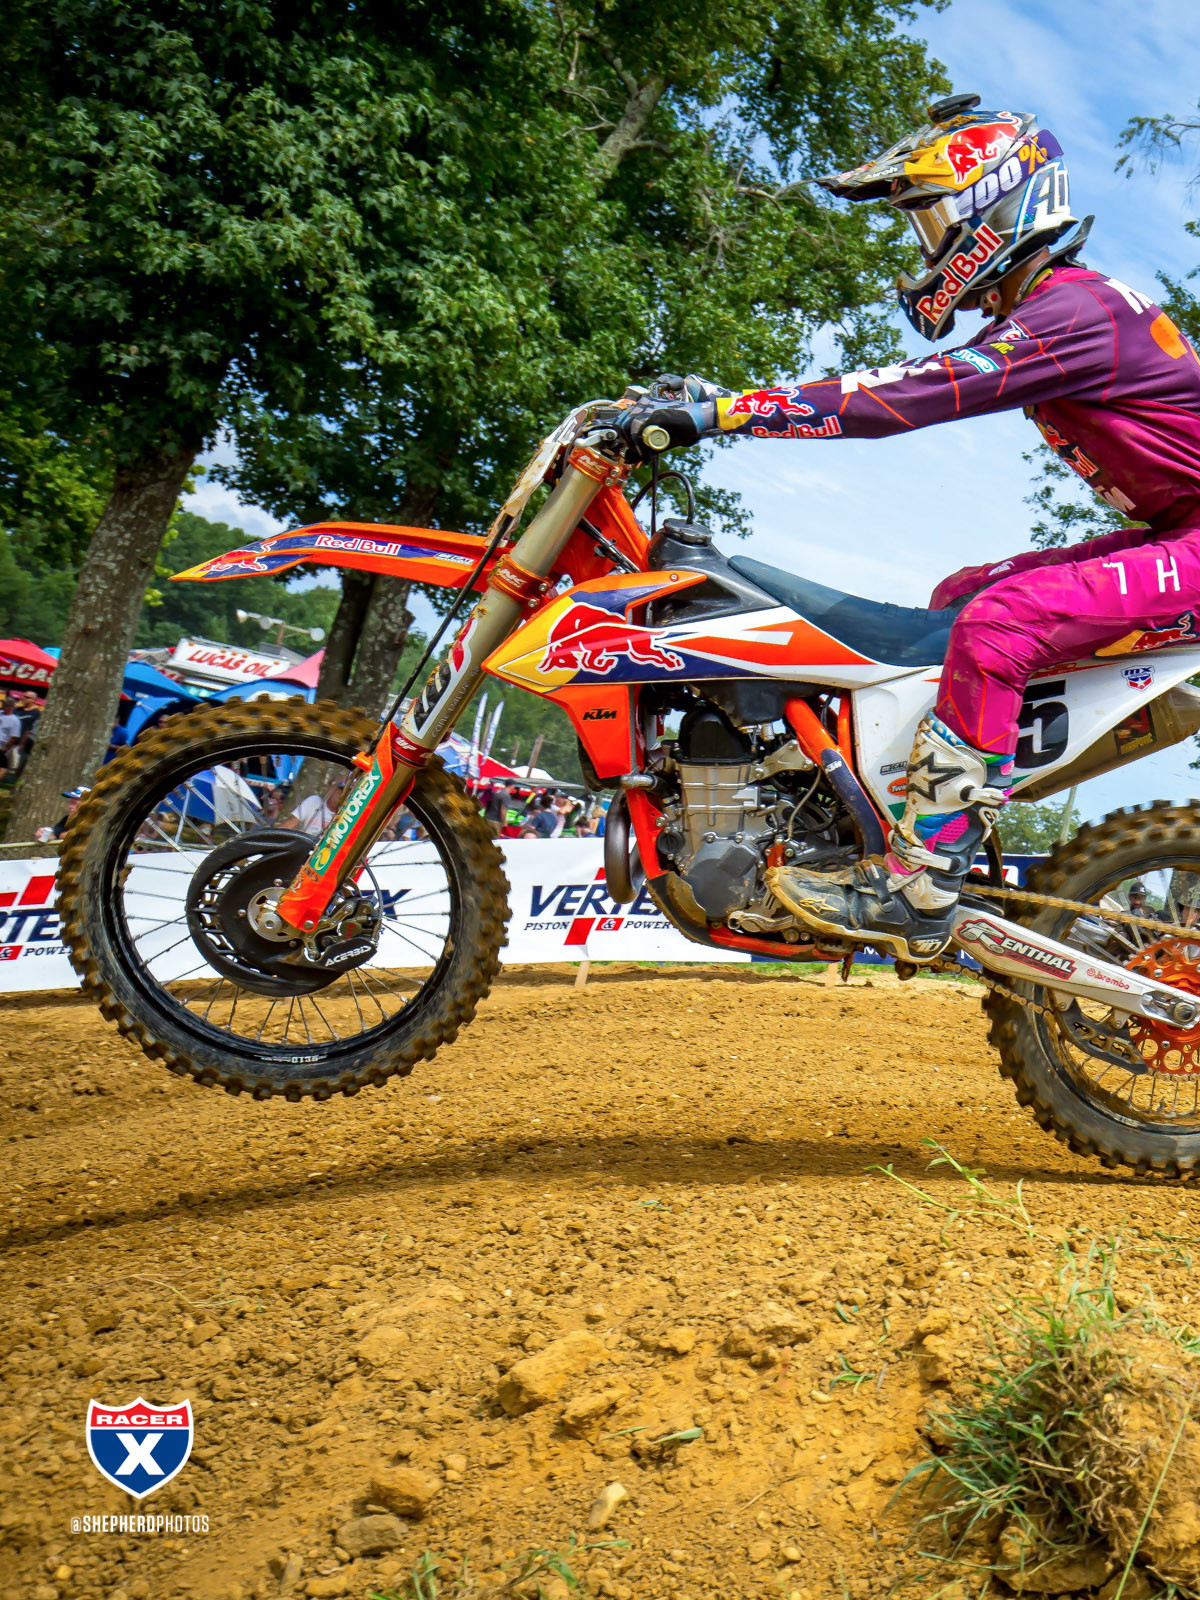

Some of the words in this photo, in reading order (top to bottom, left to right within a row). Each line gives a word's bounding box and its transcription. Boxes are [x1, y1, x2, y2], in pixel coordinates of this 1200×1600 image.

[916, 264, 964, 326] Red
[949, 221, 1005, 283] Bull
[752, 423, 797, 438] Red
[796, 415, 843, 438] Bull
[315, 534, 359, 551] Red
[358, 539, 401, 556] Bull
[187, 650, 245, 670] LUCAS
[243, 662, 273, 677] OIL
[582, 707, 618, 720] KTM
[1015, 680, 1070, 768] 5
[328, 769, 381, 851] MOTOREX
[524, 921, 570, 931] PISTON
[1095, 972, 1130, 990] brembo
